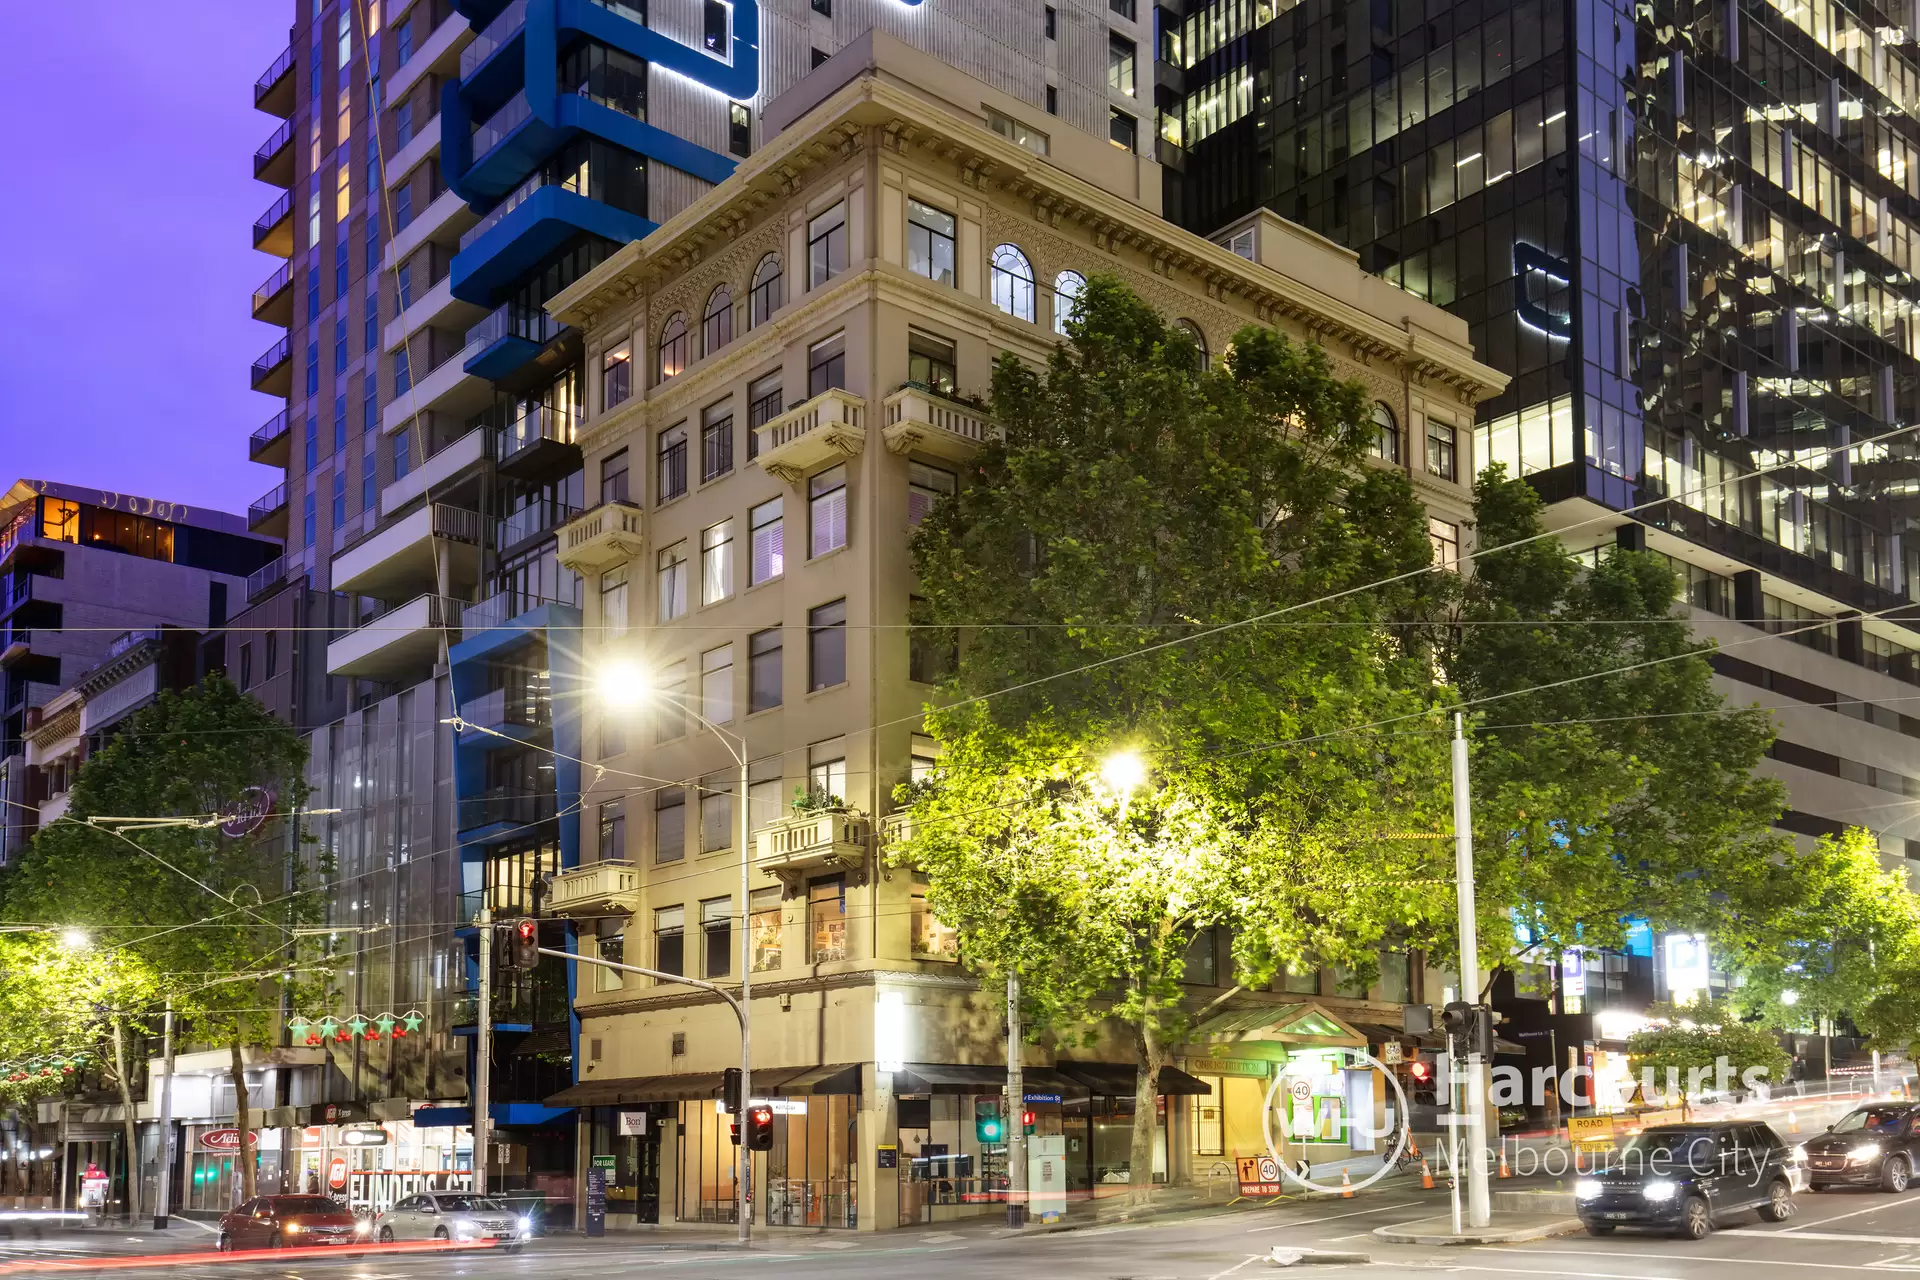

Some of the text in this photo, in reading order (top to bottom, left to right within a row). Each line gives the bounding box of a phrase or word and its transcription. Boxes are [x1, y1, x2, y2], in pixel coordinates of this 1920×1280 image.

[1295, 1086, 1308, 1095] 40
[1577, 1120, 1603, 1128] ROAD
[1574, 1143, 1602, 1151] ETOUR
[594, 1159, 602, 1167] FOR
[329, 1163, 346, 1181] IGA
[1263, 1165, 1274, 1174] 40
